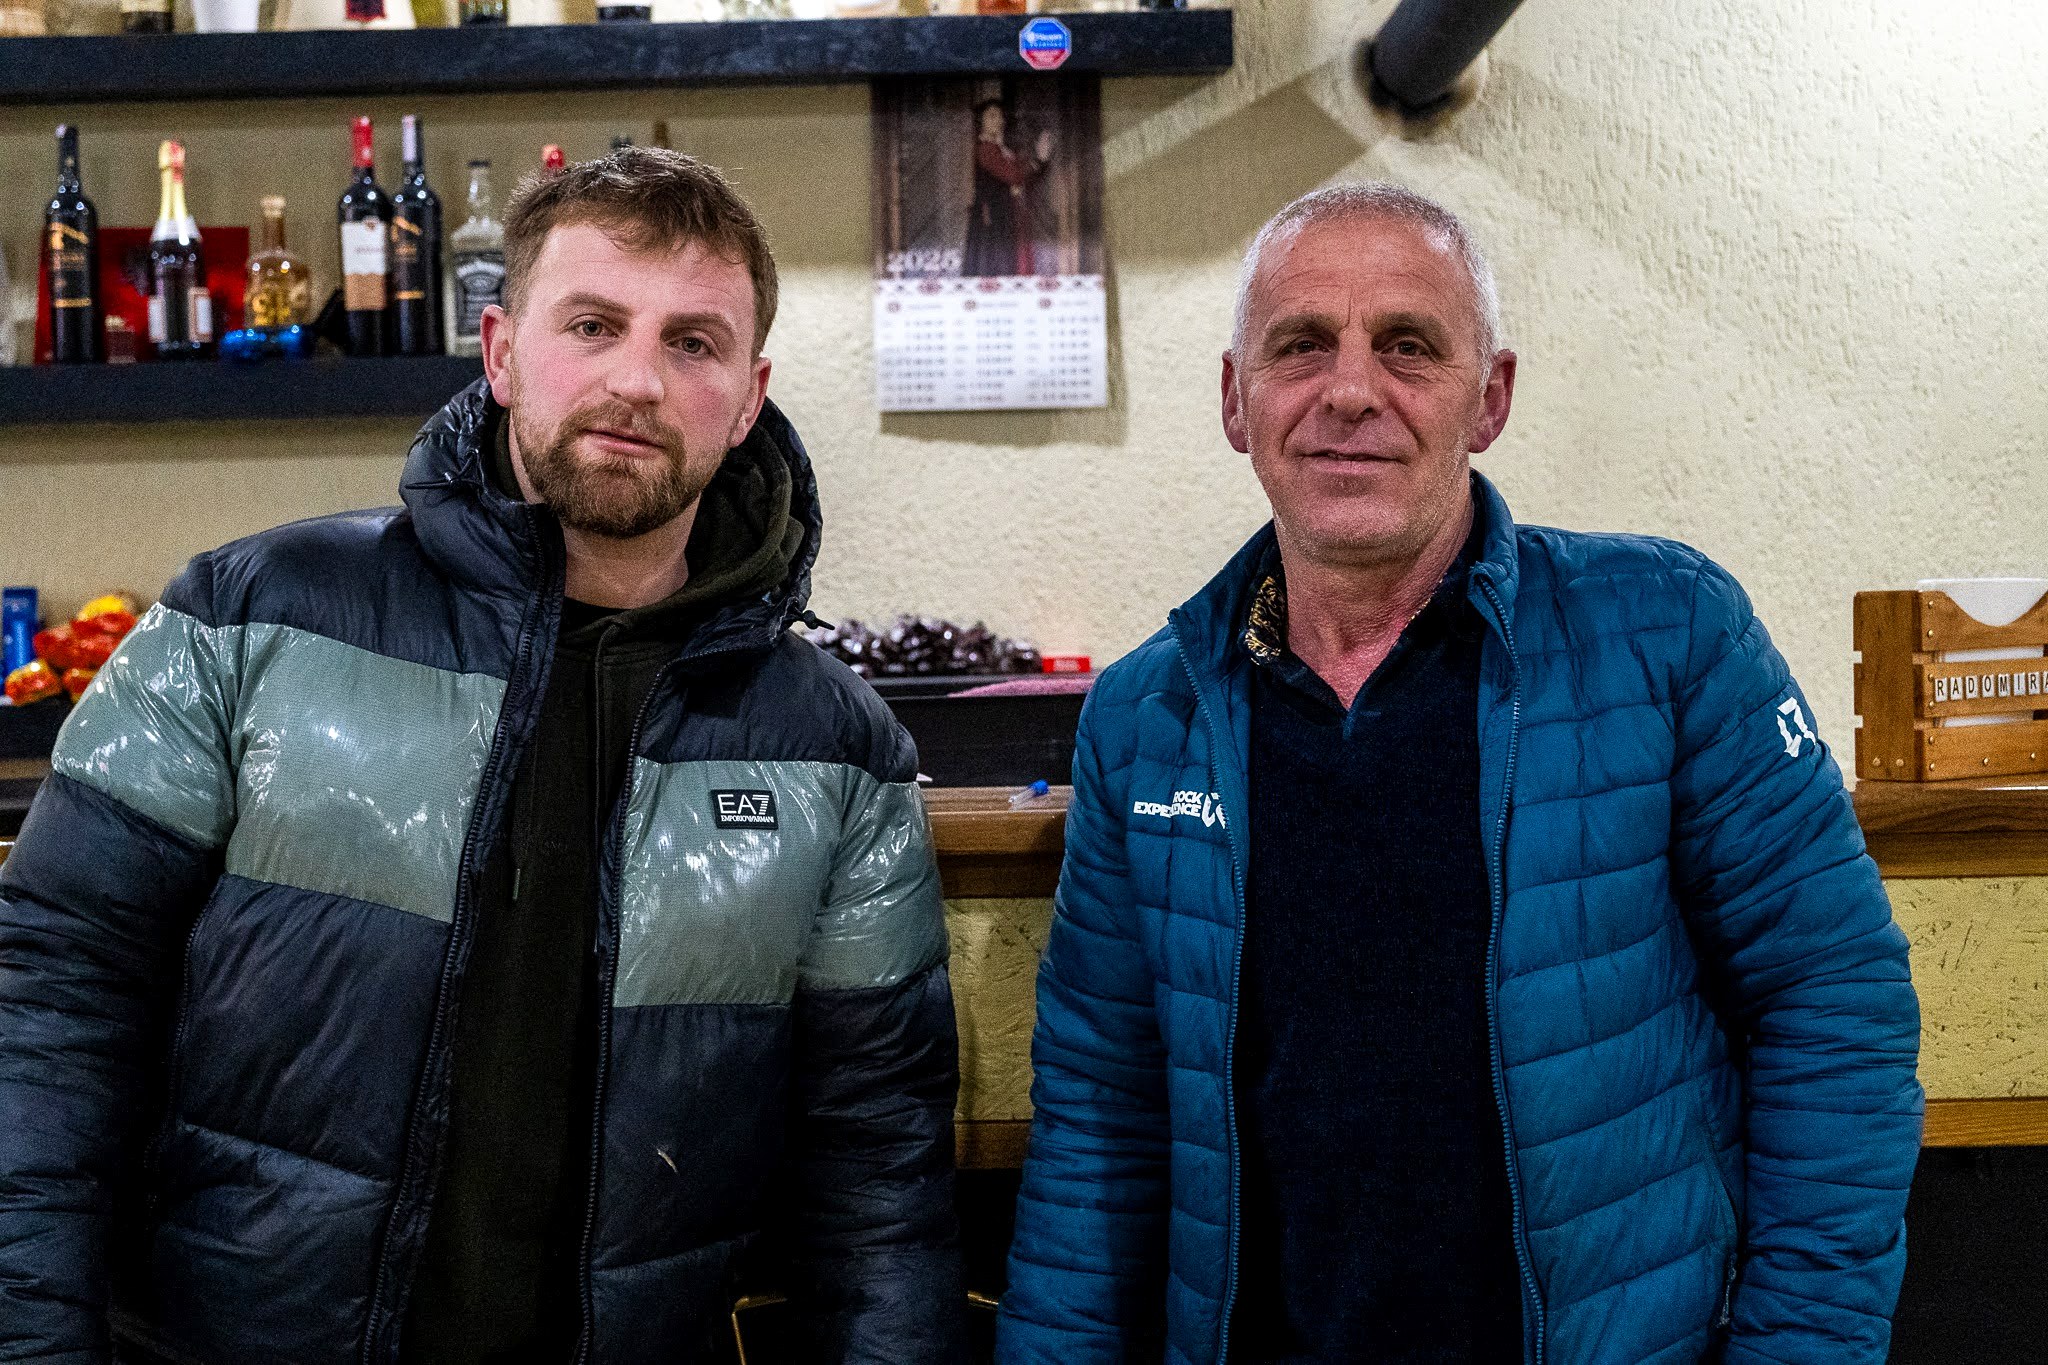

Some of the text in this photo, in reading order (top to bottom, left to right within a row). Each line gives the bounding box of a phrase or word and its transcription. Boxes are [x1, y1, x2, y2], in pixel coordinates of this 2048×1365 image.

[718, 794, 770, 815] EA7
[1173, 790, 1203, 804] ROCK
[1133, 801, 1201, 818] EXPEENCE
